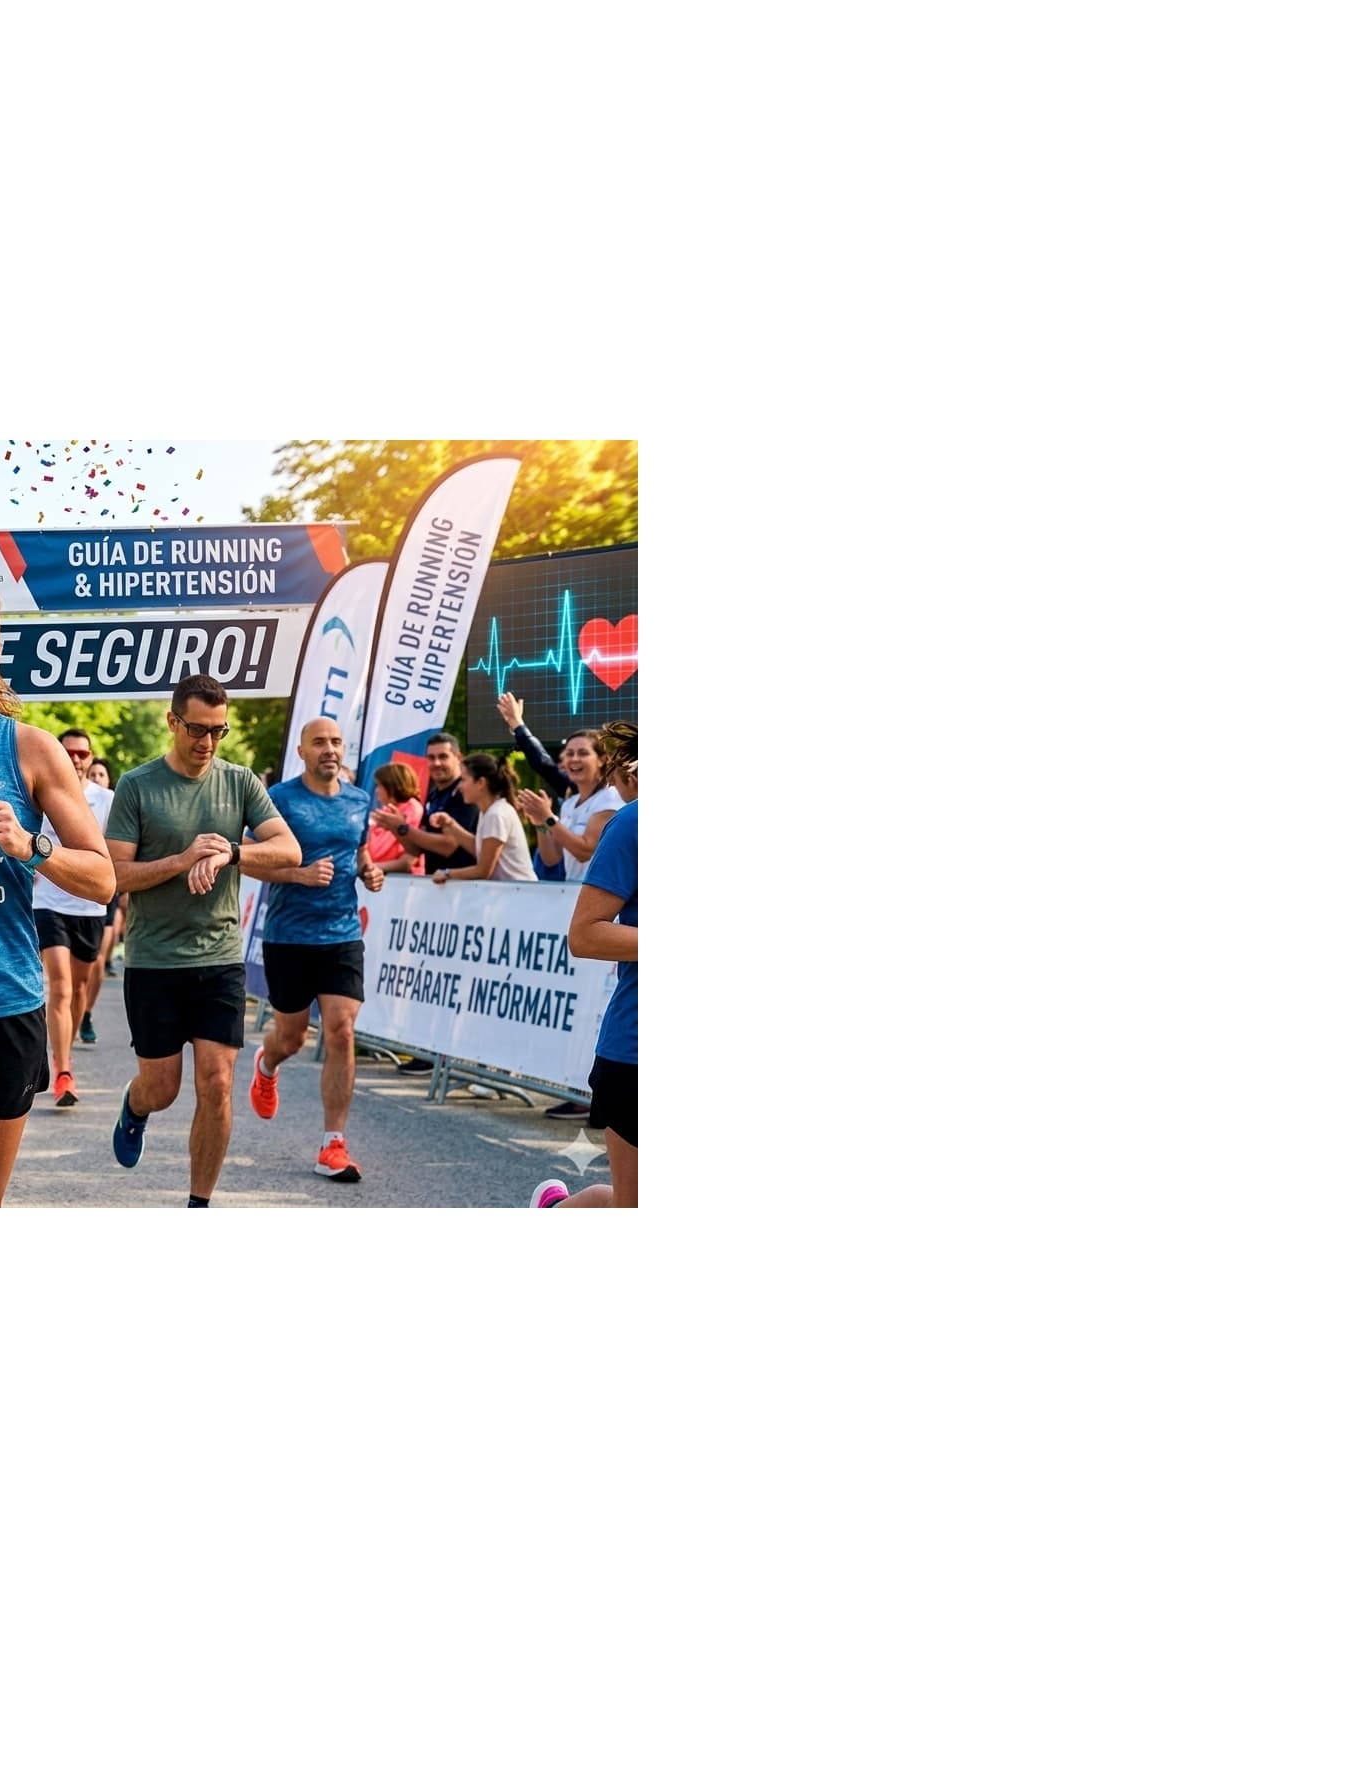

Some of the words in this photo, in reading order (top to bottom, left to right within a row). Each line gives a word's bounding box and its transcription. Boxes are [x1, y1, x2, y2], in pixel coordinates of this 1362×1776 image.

[68, 535, 127, 567] GUÍA
[133, 540, 167, 566] DE
[172, 537, 282, 565] RUNNING
[407, 517, 453, 617] RUNNING
[75, 572, 93, 597] &
[99, 564, 276, 598] HIPERTENSIÓN
[398, 620, 425, 650] DE
[418, 530, 482, 692] HIPERTENSIÓN
[30, 626, 266, 687] SEGURO!
[385, 655, 417, 706] GUÍA
[413, 699, 436, 714] &
[389, 918, 408, 951] TU
[409, 921, 459, 958] SALUD
[461, 924, 484, 962] ES
[487, 927, 510, 967] LA
[376, 960, 462, 1014] PREPÁRATE,
[467, 972, 577, 1032] INFÓRMATE
